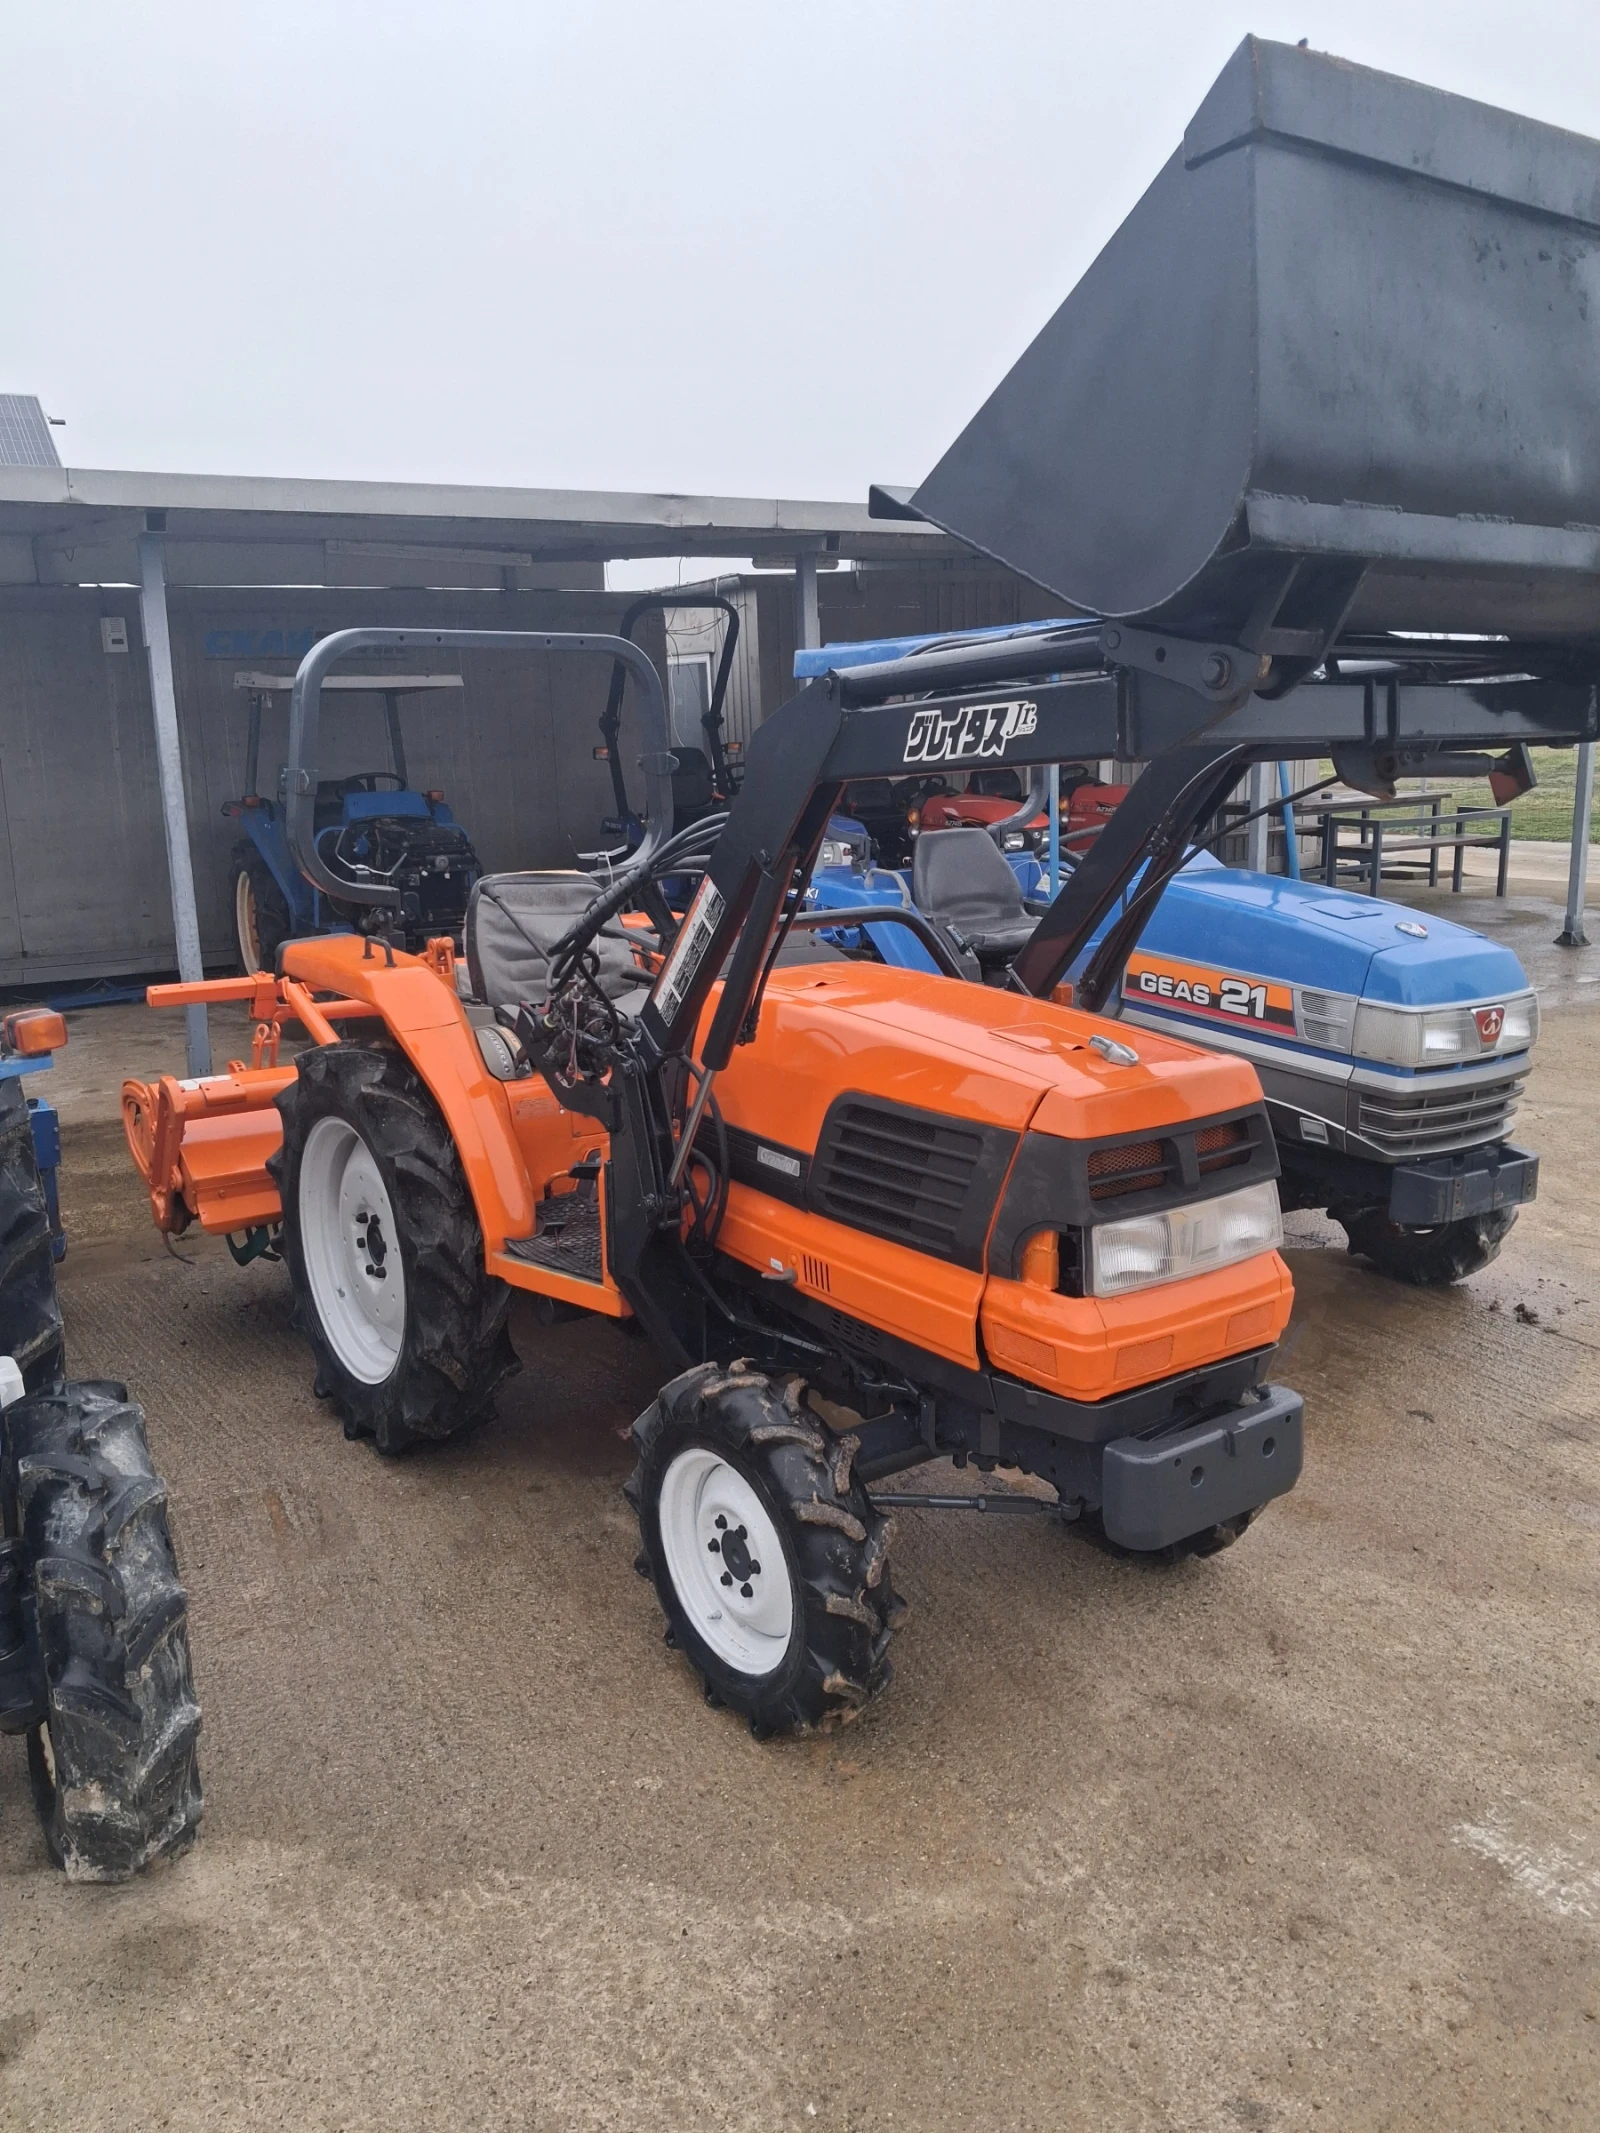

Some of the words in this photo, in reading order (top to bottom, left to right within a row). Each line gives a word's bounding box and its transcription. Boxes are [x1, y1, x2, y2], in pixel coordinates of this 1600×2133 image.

[905, 706, 1009, 759] グレイタス
[1140, 972, 1210, 1006] GEAS
[1220, 979, 1268, 1019] 21
